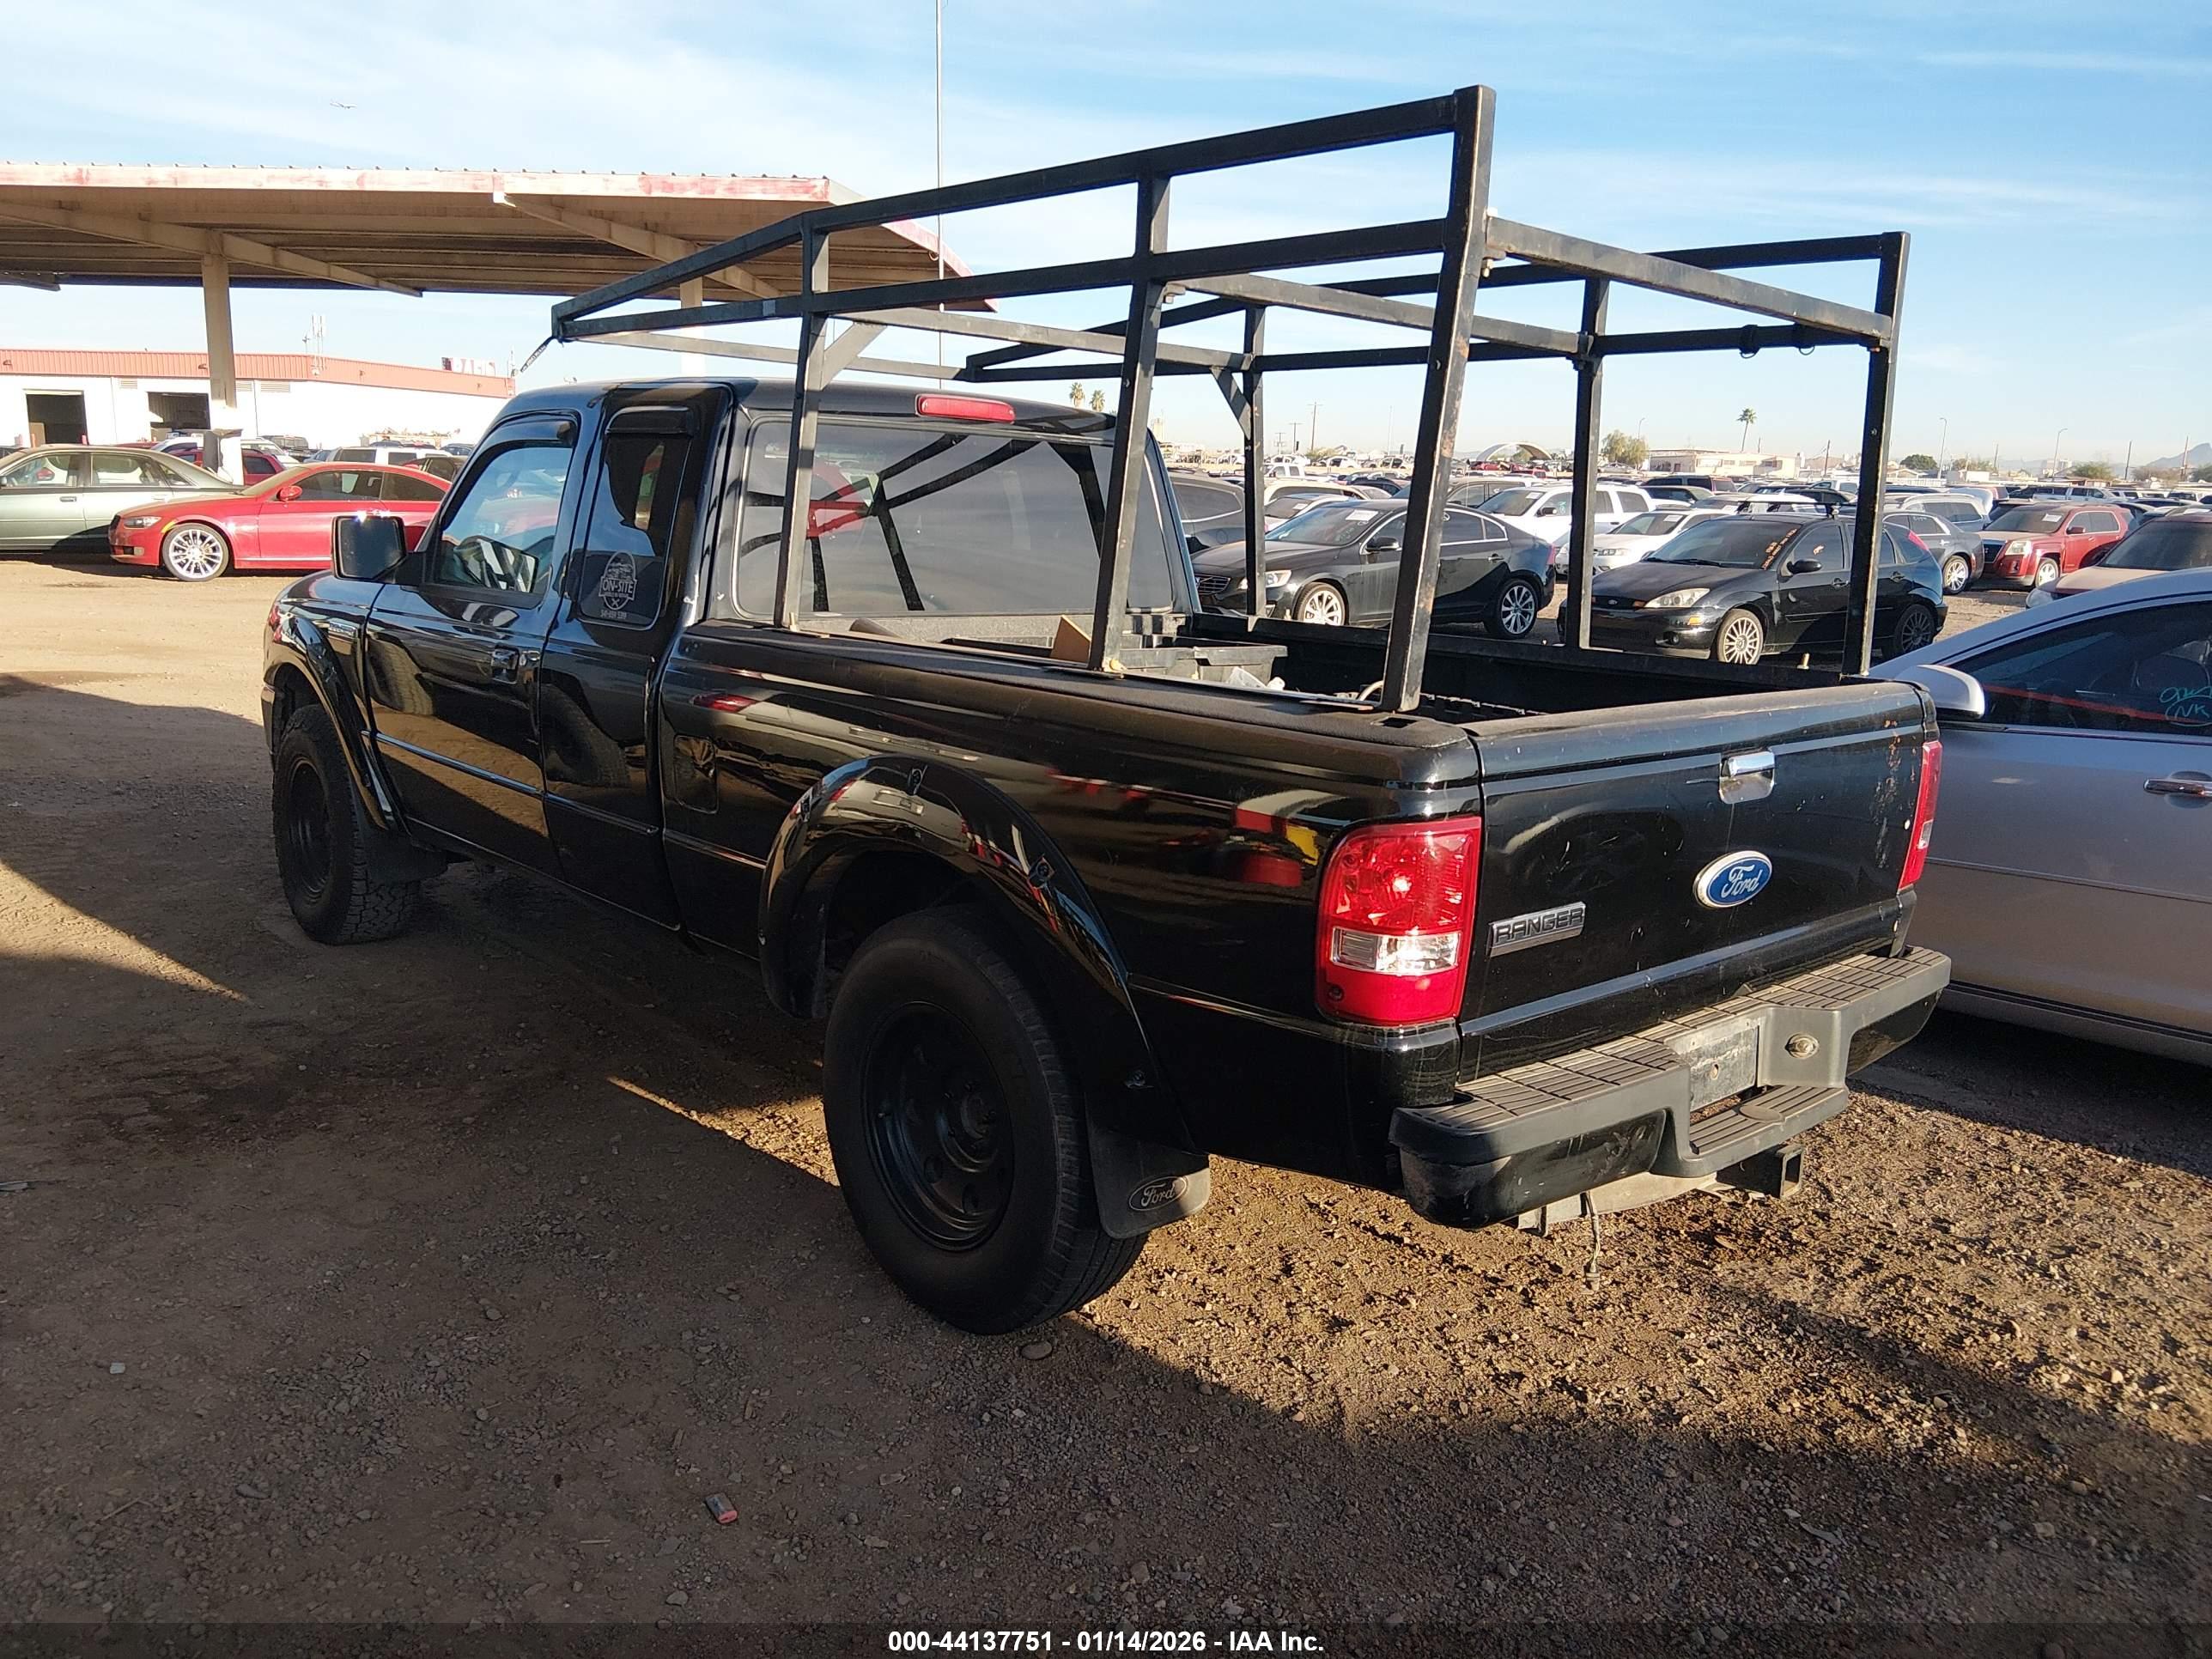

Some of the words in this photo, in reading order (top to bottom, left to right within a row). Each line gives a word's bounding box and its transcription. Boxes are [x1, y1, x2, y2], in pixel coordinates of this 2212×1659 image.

[1722, 865, 1762, 897] Ford
[1496, 907, 1584, 944] RANGER
[1141, 1182, 1176, 1206] Ford
